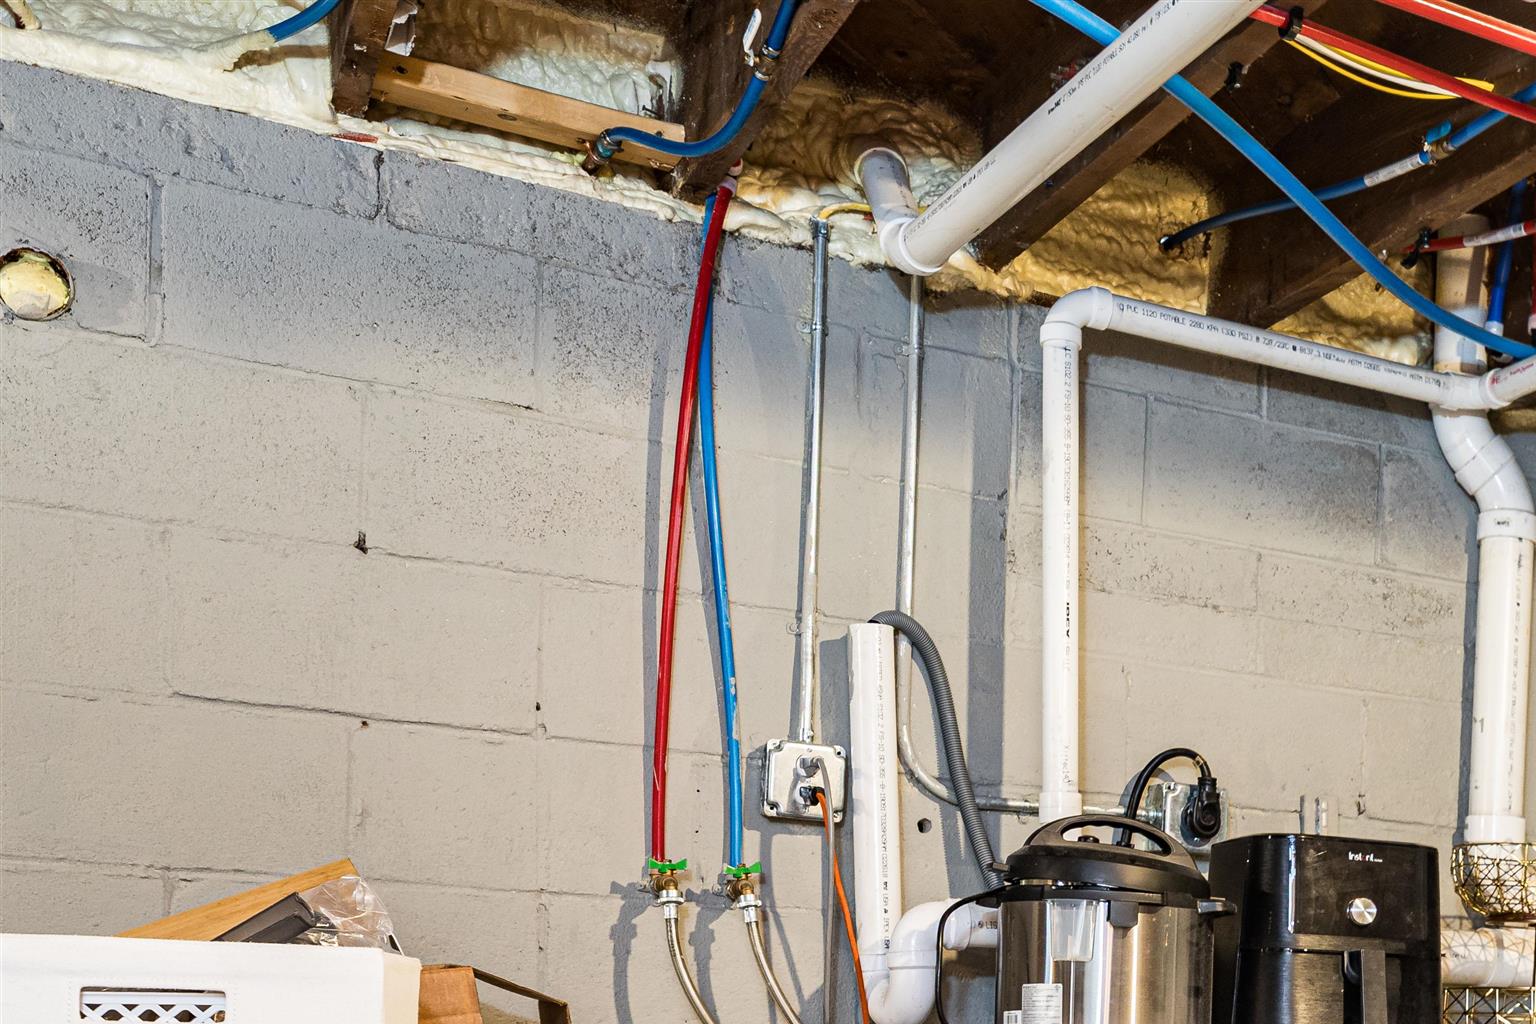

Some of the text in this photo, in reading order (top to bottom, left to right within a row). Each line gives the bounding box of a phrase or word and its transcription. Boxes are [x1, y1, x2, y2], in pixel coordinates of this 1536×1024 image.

[1126, 304, 1139, 315] PVC
[1142, 309, 1157, 319] 1120
[1159, 313, 1186, 326] POTABLE
